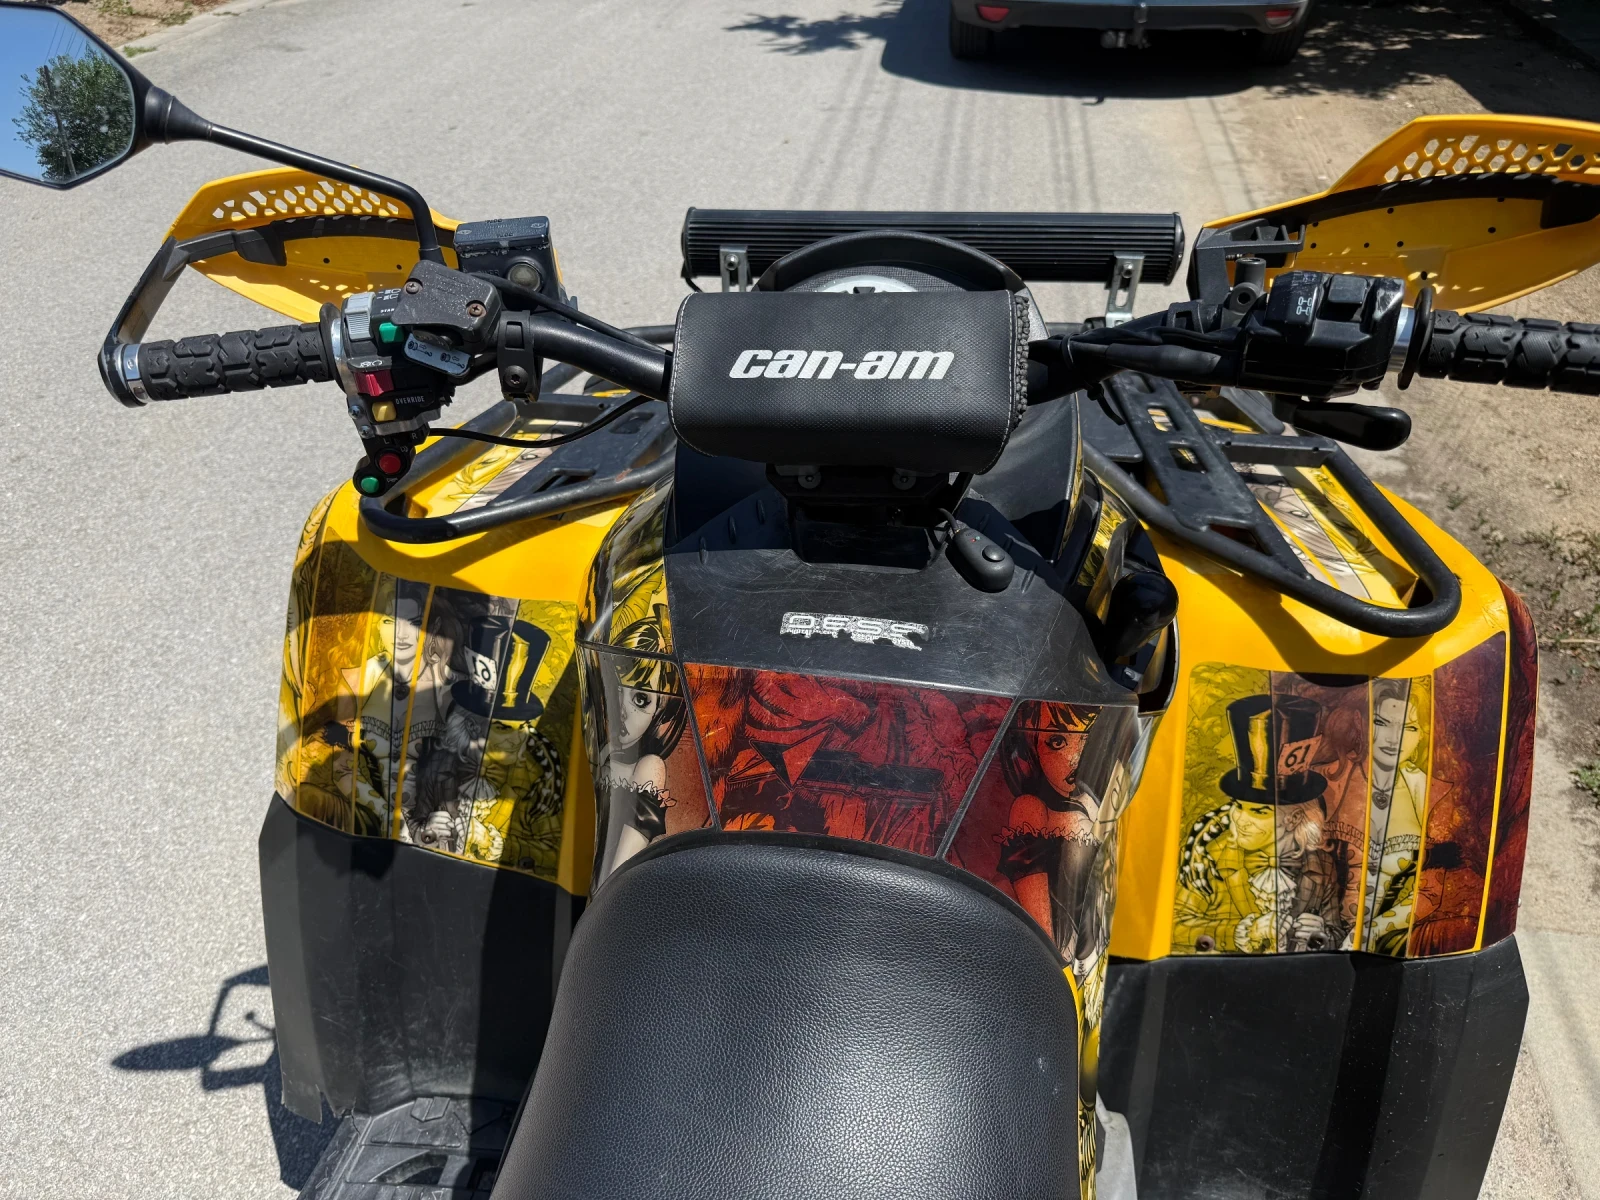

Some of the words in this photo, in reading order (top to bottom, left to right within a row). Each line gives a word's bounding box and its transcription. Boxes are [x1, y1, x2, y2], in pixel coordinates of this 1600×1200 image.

[728, 349, 955, 380] can-am
[395, 395, 425, 405] OVERRIDE
[383, 437, 390, 445] L
[411, 432, 418, 440] R
[1284, 744, 1311, 768] 61
